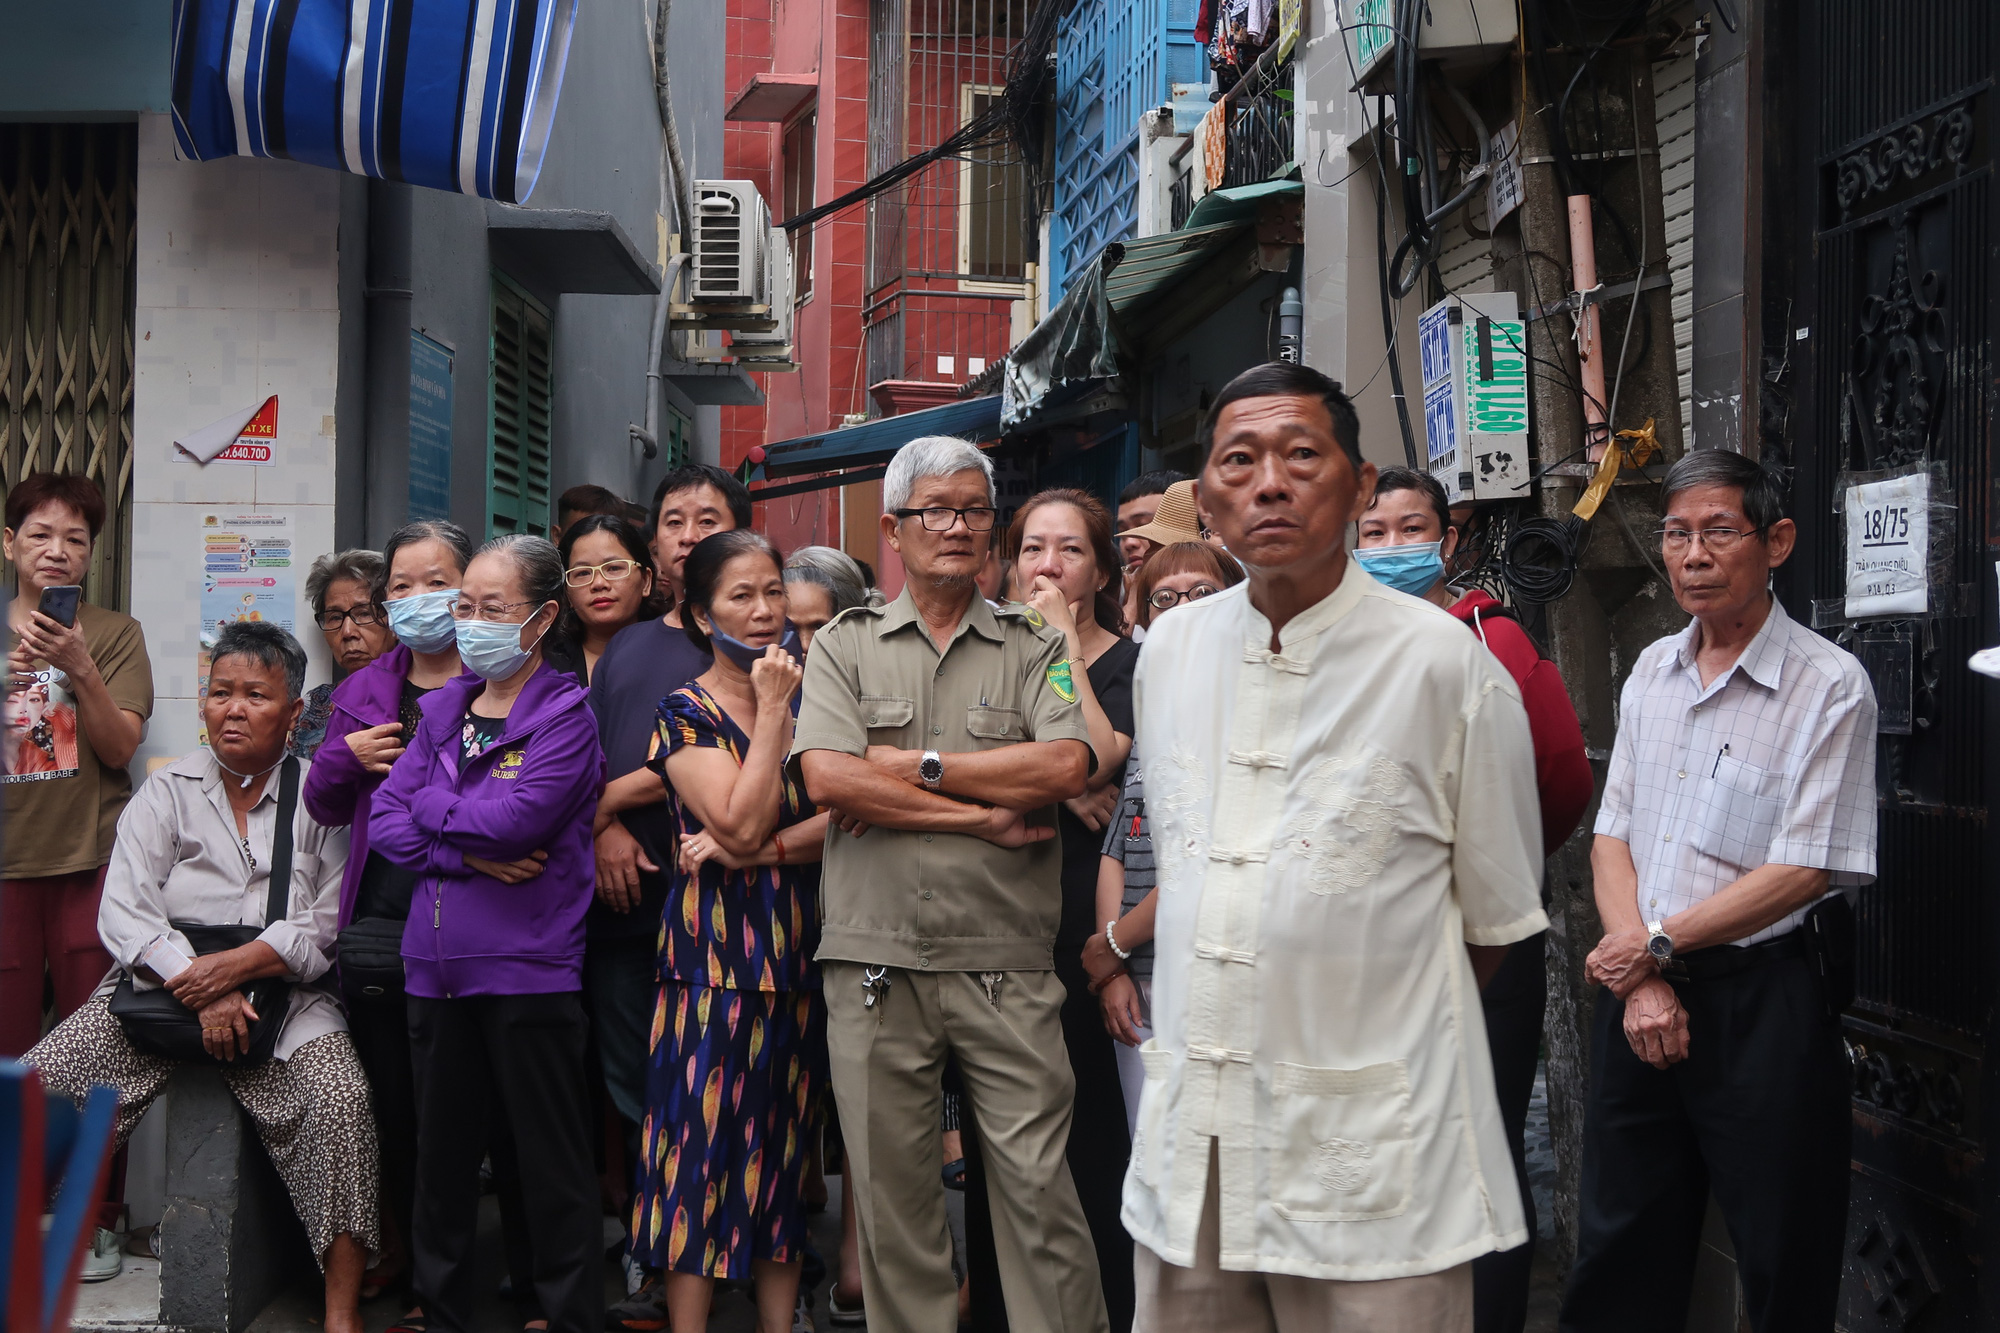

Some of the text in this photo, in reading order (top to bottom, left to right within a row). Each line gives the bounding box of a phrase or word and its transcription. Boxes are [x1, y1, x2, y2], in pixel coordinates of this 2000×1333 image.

[259, 425, 272, 433] XE
[1864, 505, 1908, 543] 18/75
[1855, 558, 1869, 572] TRẦN
[1893, 557, 1908, 572] DIỆU
[3, 768, 74, 783] YOURSELF BABE
